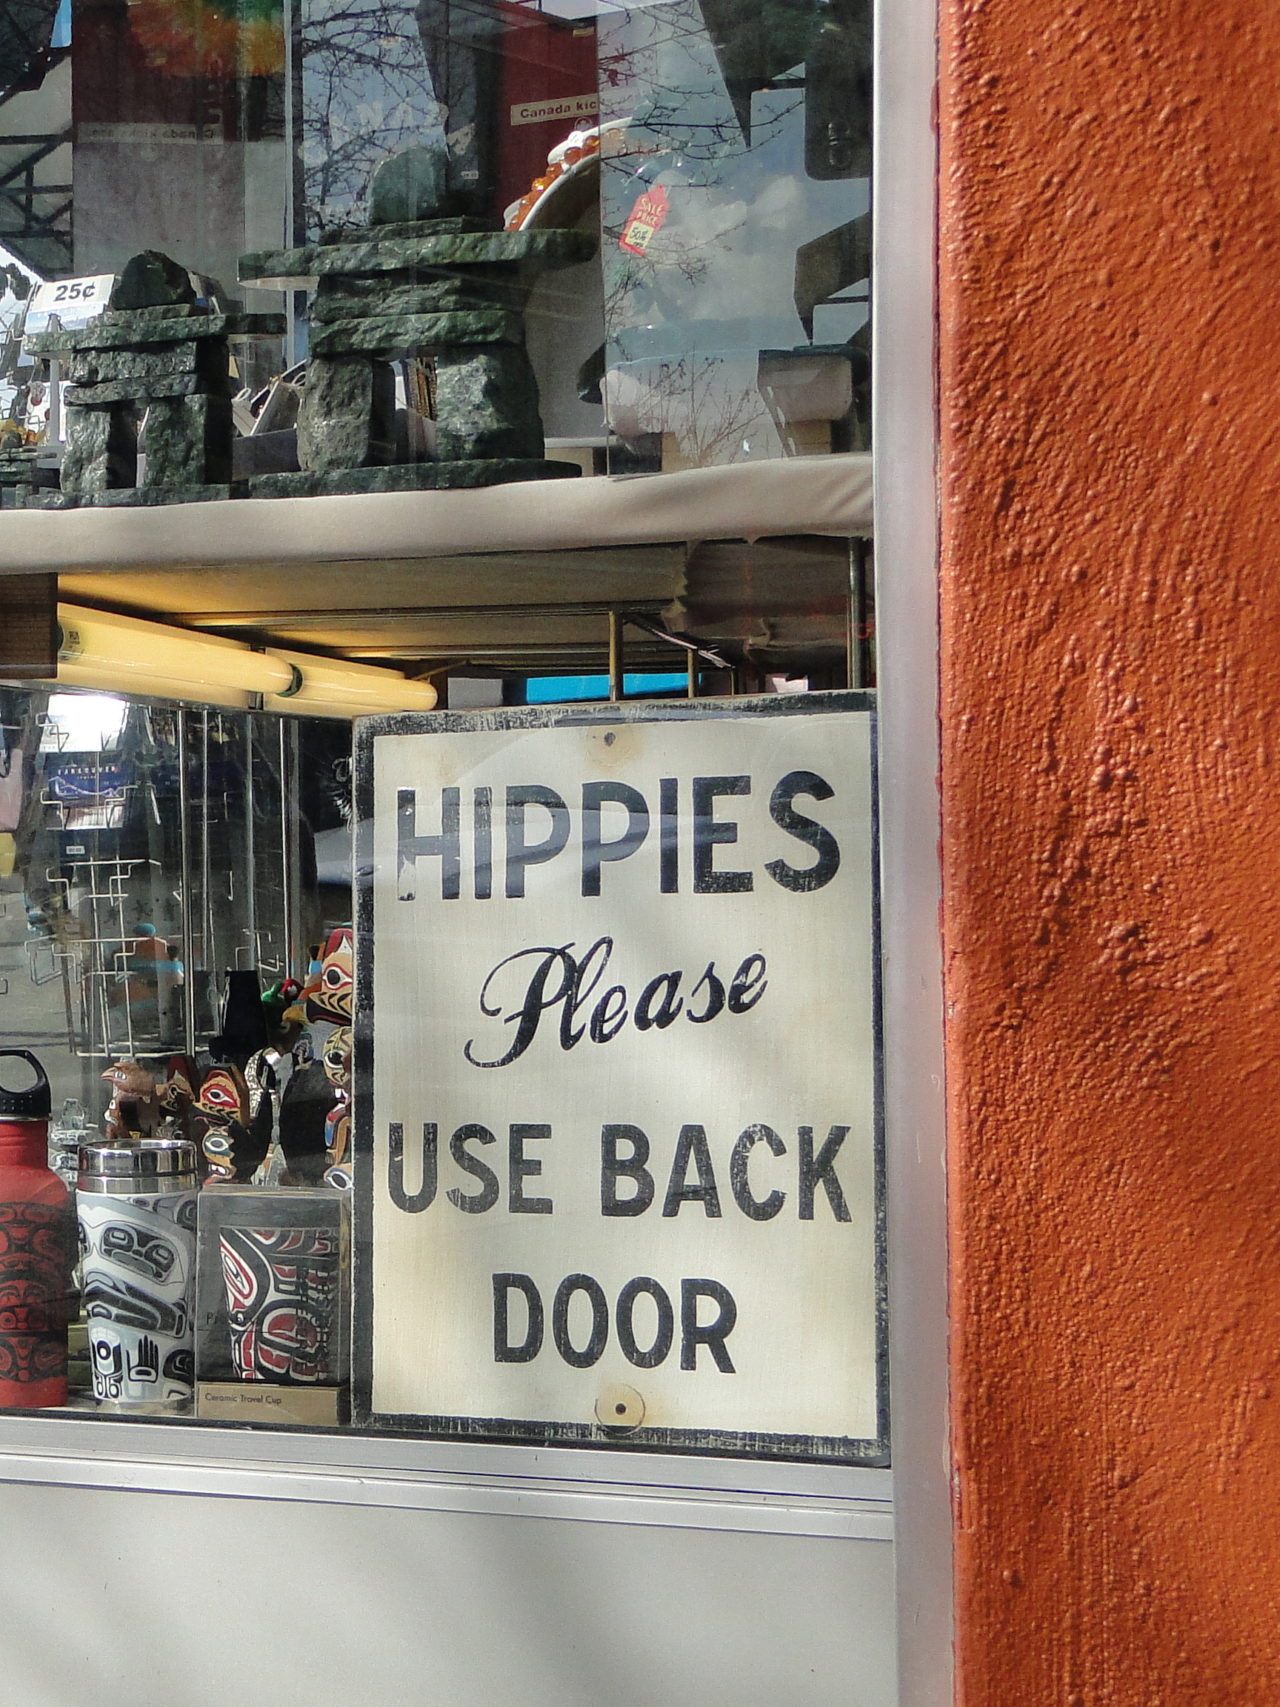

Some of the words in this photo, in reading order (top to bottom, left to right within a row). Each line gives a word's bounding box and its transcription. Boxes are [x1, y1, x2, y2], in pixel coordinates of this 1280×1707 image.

[520, 103, 571, 119] Canada
[54, 282, 96, 301] 25¢
[396, 770, 841, 902] HIPPIES
[463, 937, 769, 1069] Please
[386, 1121, 554, 1215] USE
[600, 1123, 854, 1223] BACK
[491, 1272, 738, 1374] DOOR
[205, 1393, 238, 1403] Ceramic
[241, 1394, 263, 1404] Travel
[265, 1395, 282, 1406] Cup
